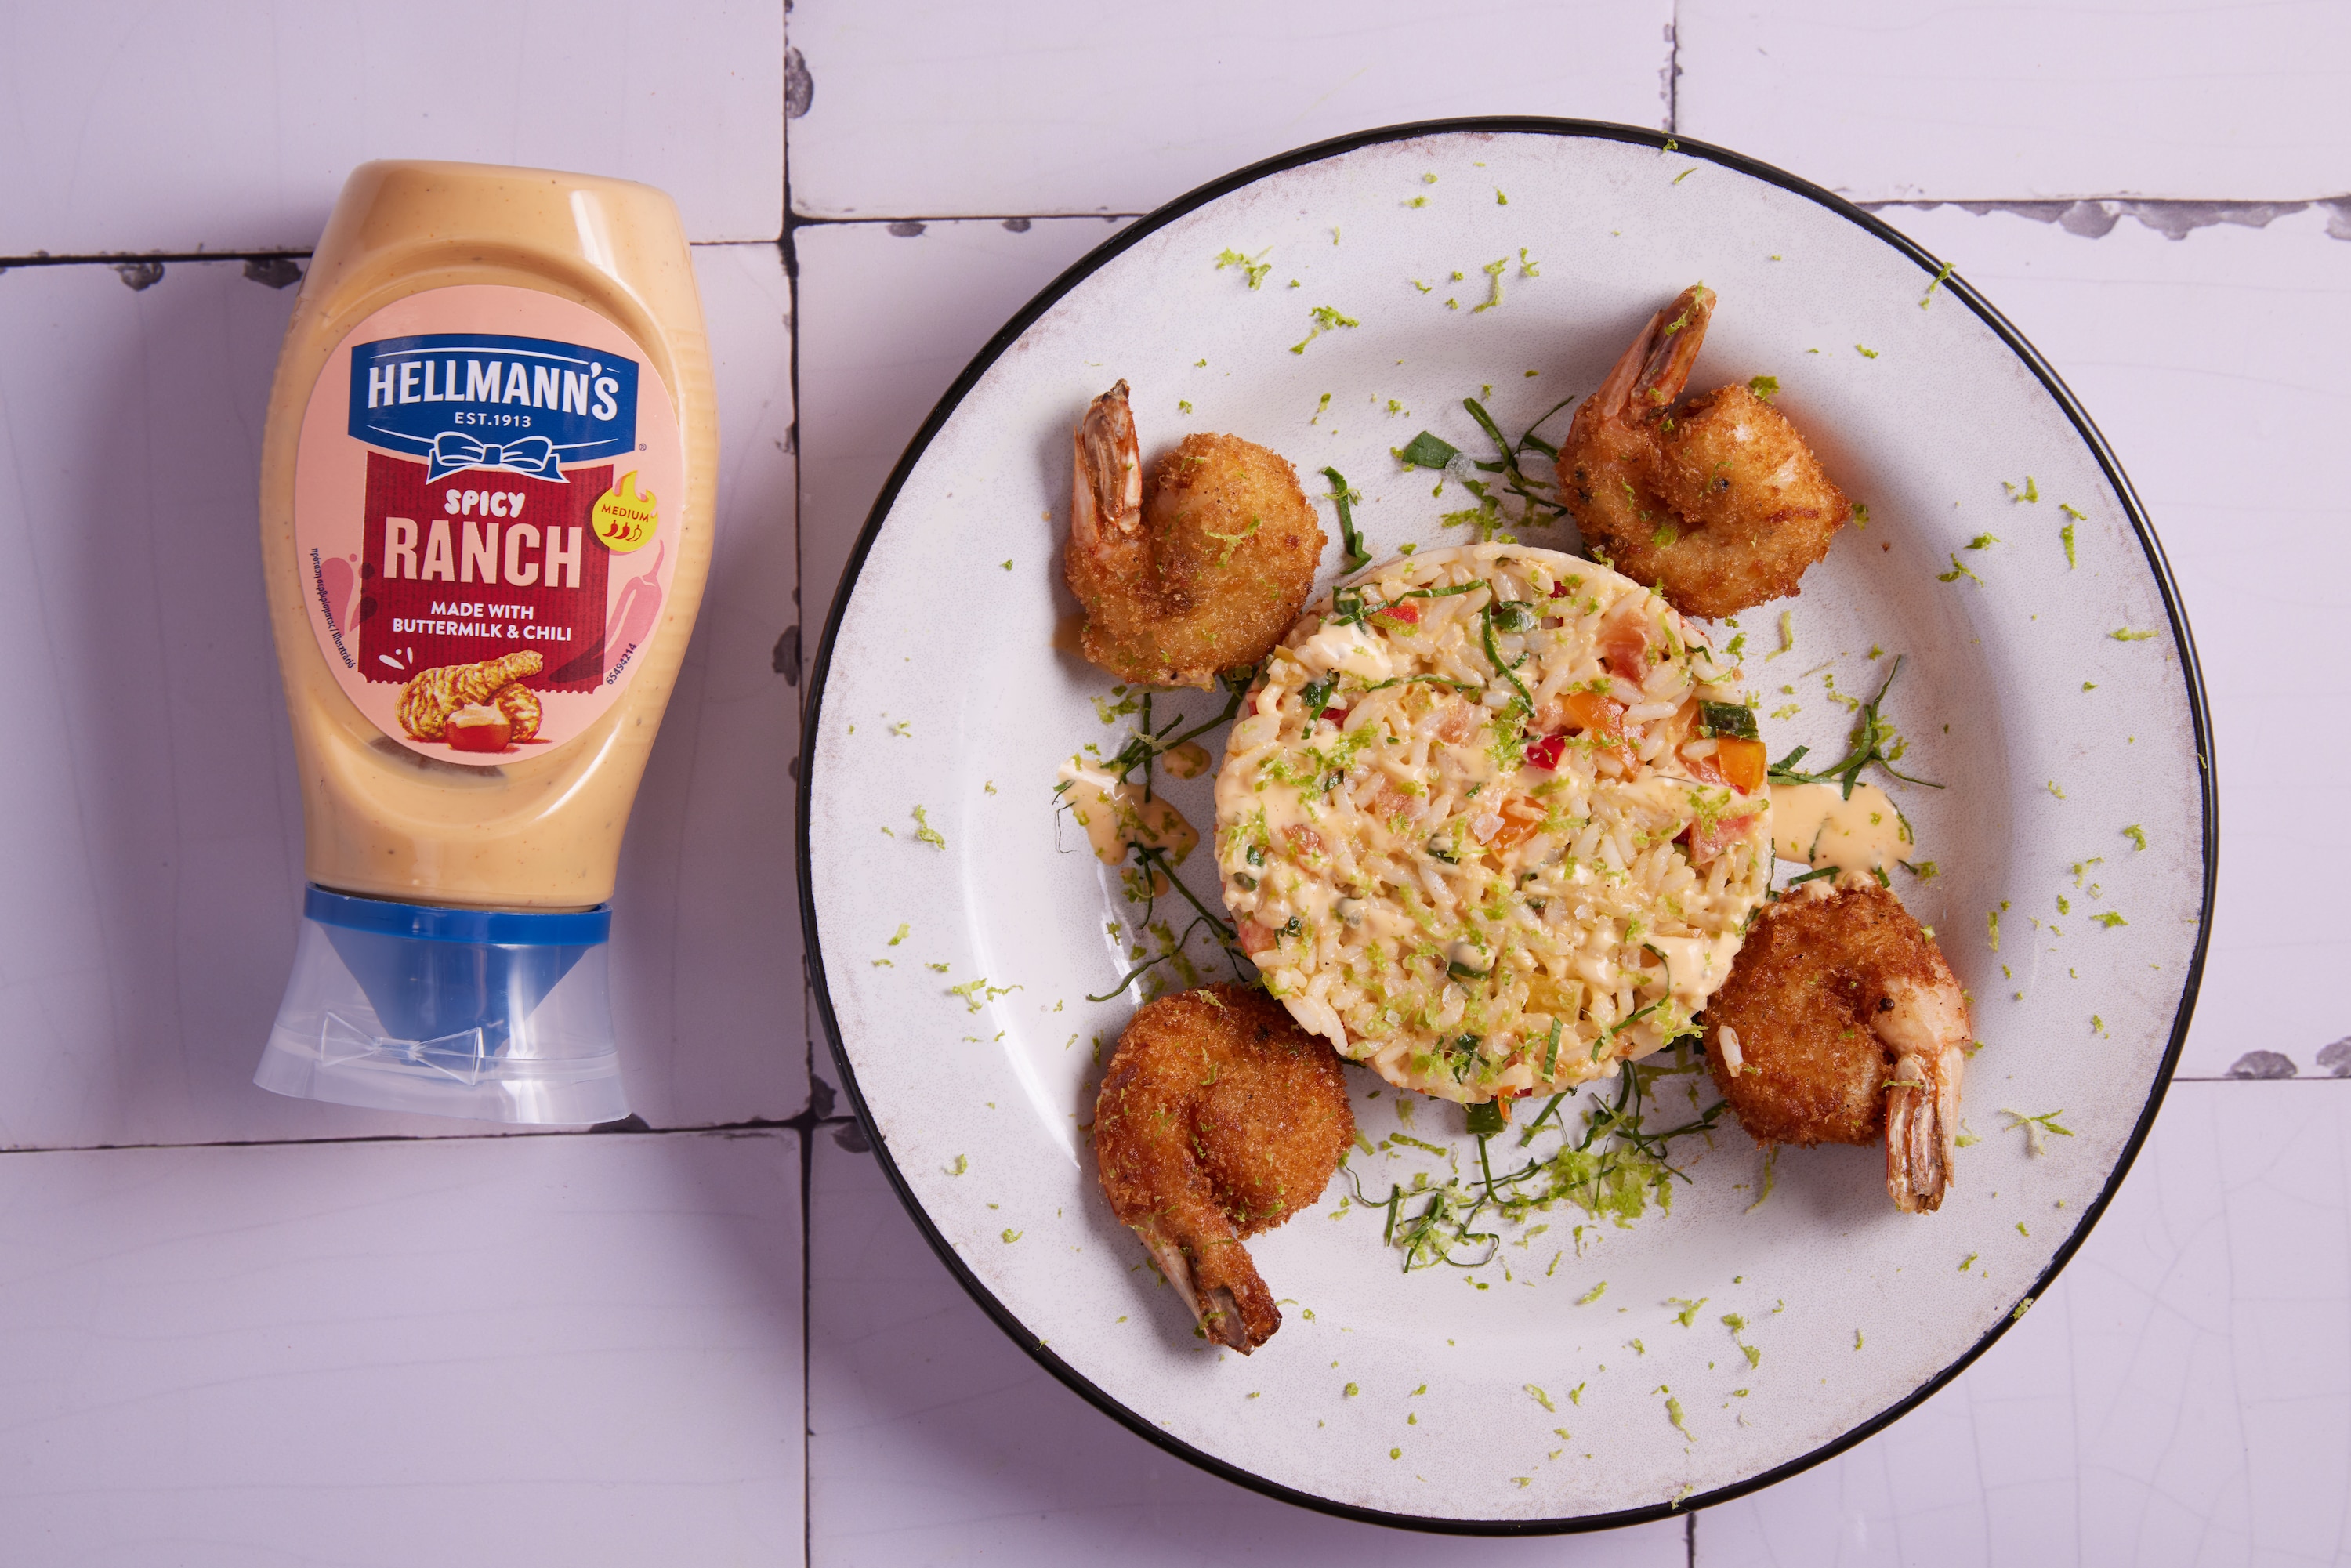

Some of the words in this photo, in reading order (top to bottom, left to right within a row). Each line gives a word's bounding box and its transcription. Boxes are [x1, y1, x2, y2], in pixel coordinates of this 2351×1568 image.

[368, 360, 619, 421] HELLMANN'S
[455, 411, 531, 427] EST.1913
[444, 488, 526, 518] SPICY
[601, 503, 650, 523] MEDIUM
[383, 516, 583, 588] RANCH
[430, 600, 484, 617] MADE
[488, 603, 534, 620] WITH
[393, 618, 502, 638] BUTTERMILK
[507, 625, 520, 639] &
[523, 625, 571, 641] CHILI
[606, 643, 636, 685] 65494214
